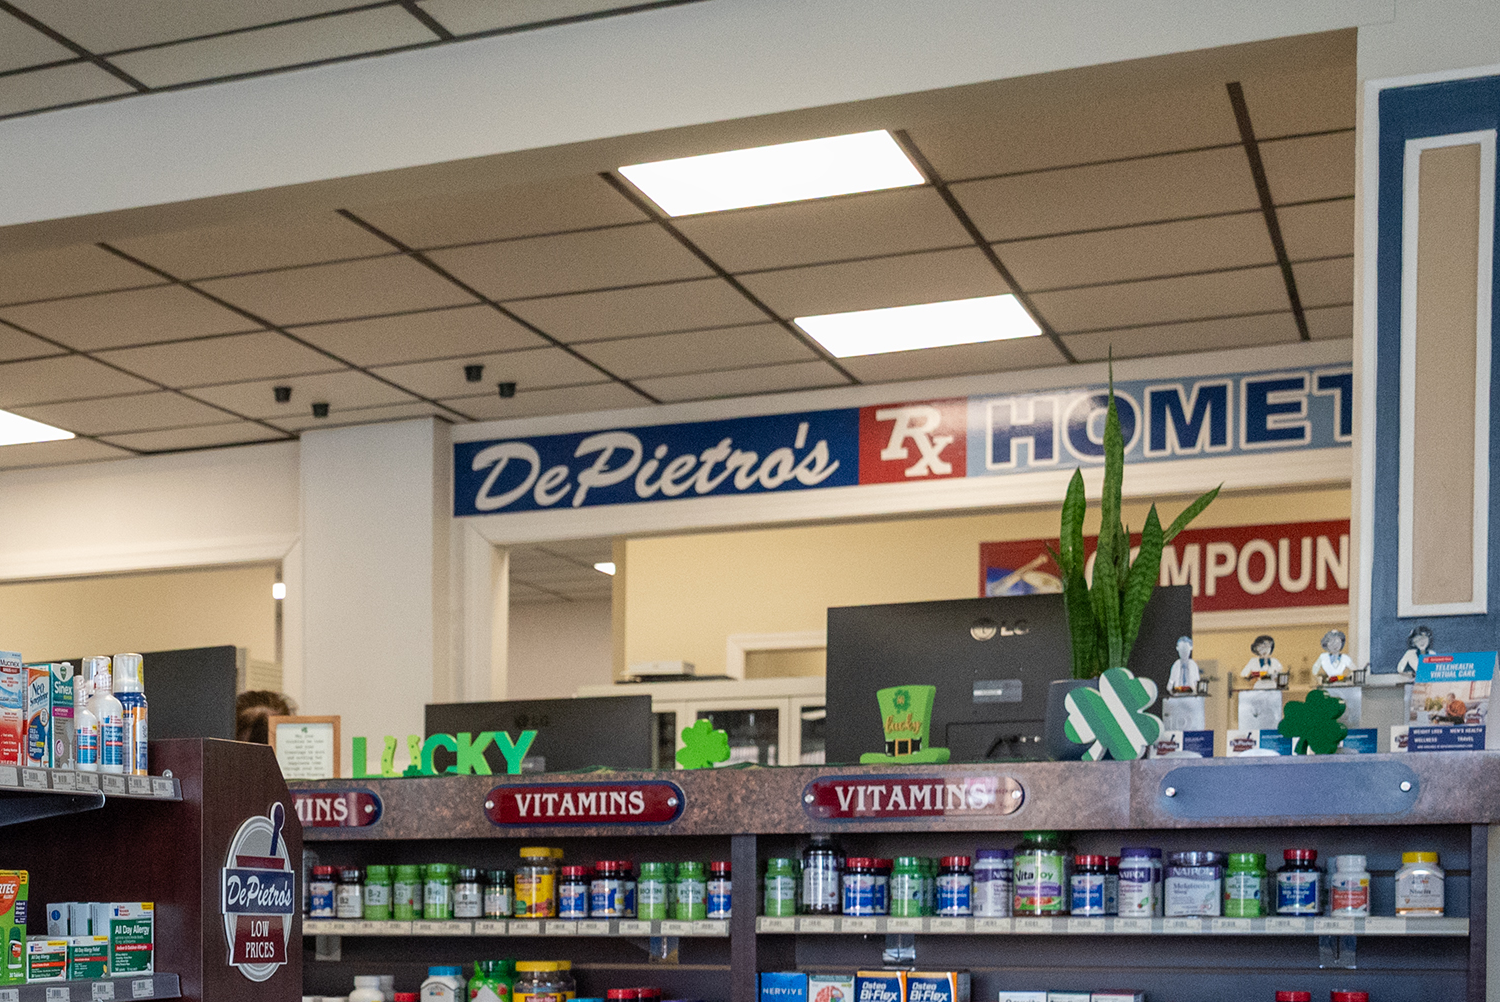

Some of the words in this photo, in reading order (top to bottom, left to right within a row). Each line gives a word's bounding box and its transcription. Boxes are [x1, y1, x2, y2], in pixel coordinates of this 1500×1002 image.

[471, 423, 840, 511] DePietro's
[1436, 663, 1474, 671] TELEHEALTH
[352, 730, 538, 779] LUCKY
[515, 791, 645, 817] VITAMINS
[835, 784, 987, 811] VITAMINS
[227, 875, 292, 907] DePietro's
[251, 921, 269, 937] LOW
[245, 942, 274, 958] PRICES
[763, 987, 802, 995] NERVIVE
[862, 981, 886, 991] Osteo
[912, 982, 937, 991] Osteo
